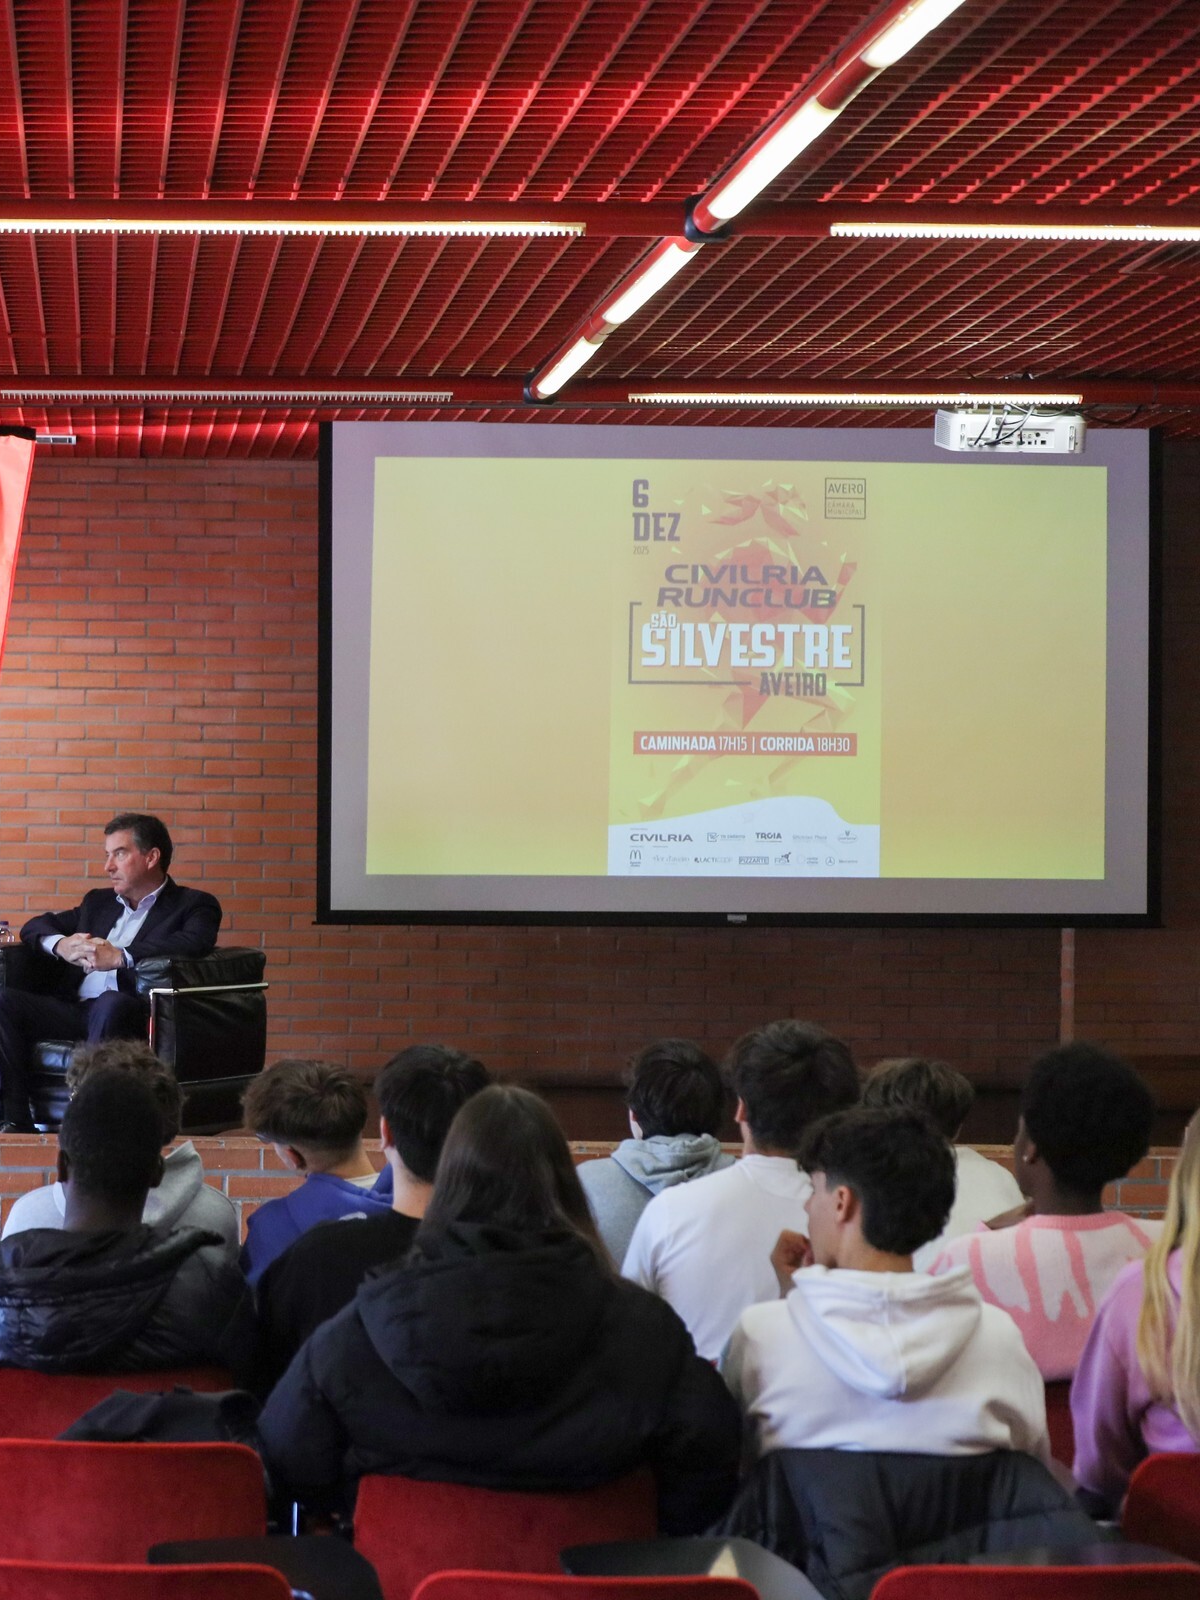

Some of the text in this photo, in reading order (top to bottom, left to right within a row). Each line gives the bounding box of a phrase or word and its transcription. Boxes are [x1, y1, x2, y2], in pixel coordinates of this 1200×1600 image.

[632, 479, 649, 508] 6
[828, 483, 864, 494] AVEIRO
[632, 512, 681, 541] DEZ
[664, 564, 829, 585] CIVILRIA
[656, 587, 837, 609] RUNCLUB
[650, 610, 677, 629] SÃO
[641, 622, 854, 669] SILVESTRE
[759, 672, 827, 697] AVEIRO
[640, 735, 850, 752] CAMINHADA 17H15 CORRIDA 18H30
[630, 833, 693, 842] CIVILRIA
